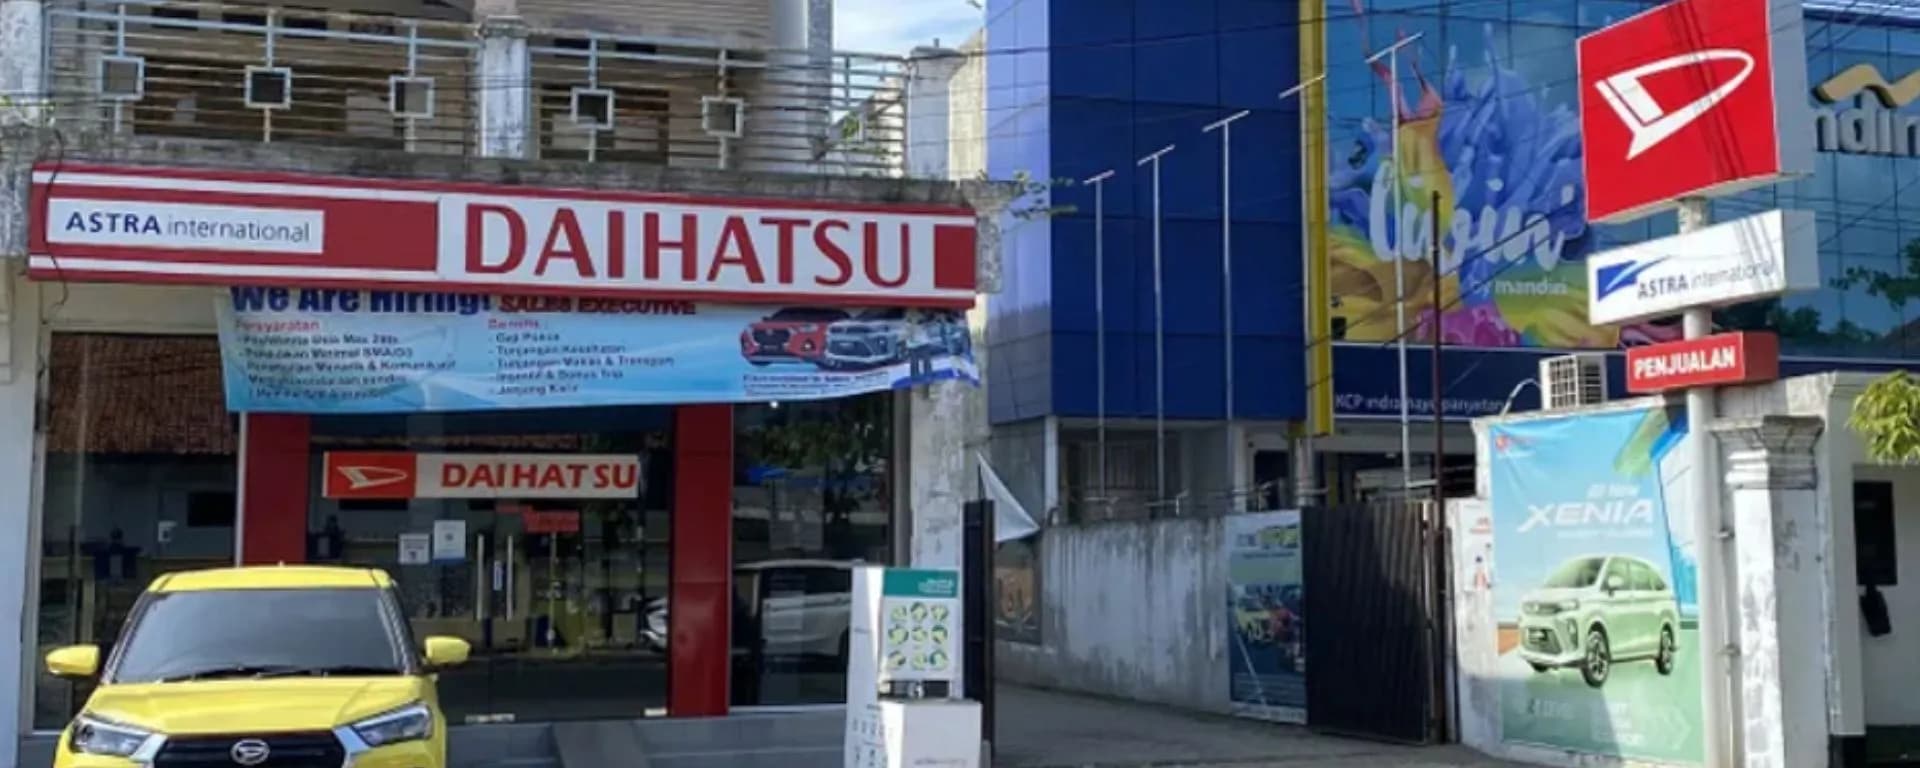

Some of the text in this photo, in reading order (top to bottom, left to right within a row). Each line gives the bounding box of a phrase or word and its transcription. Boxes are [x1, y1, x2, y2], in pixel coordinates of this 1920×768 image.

[65, 211, 310, 243] ASTRA international
[465, 203, 911, 288] DAIHATSU
[1637, 260, 1776, 300] ASTRA international
[230, 287, 290, 313] We
[298, 289, 361, 313] Are
[1633, 346, 1736, 380] PENJUALAN
[1336, 394, 1361, 409] KCP
[440, 463, 637, 490] DAIHATSU
[1518, 499, 1655, 533] XENIA
